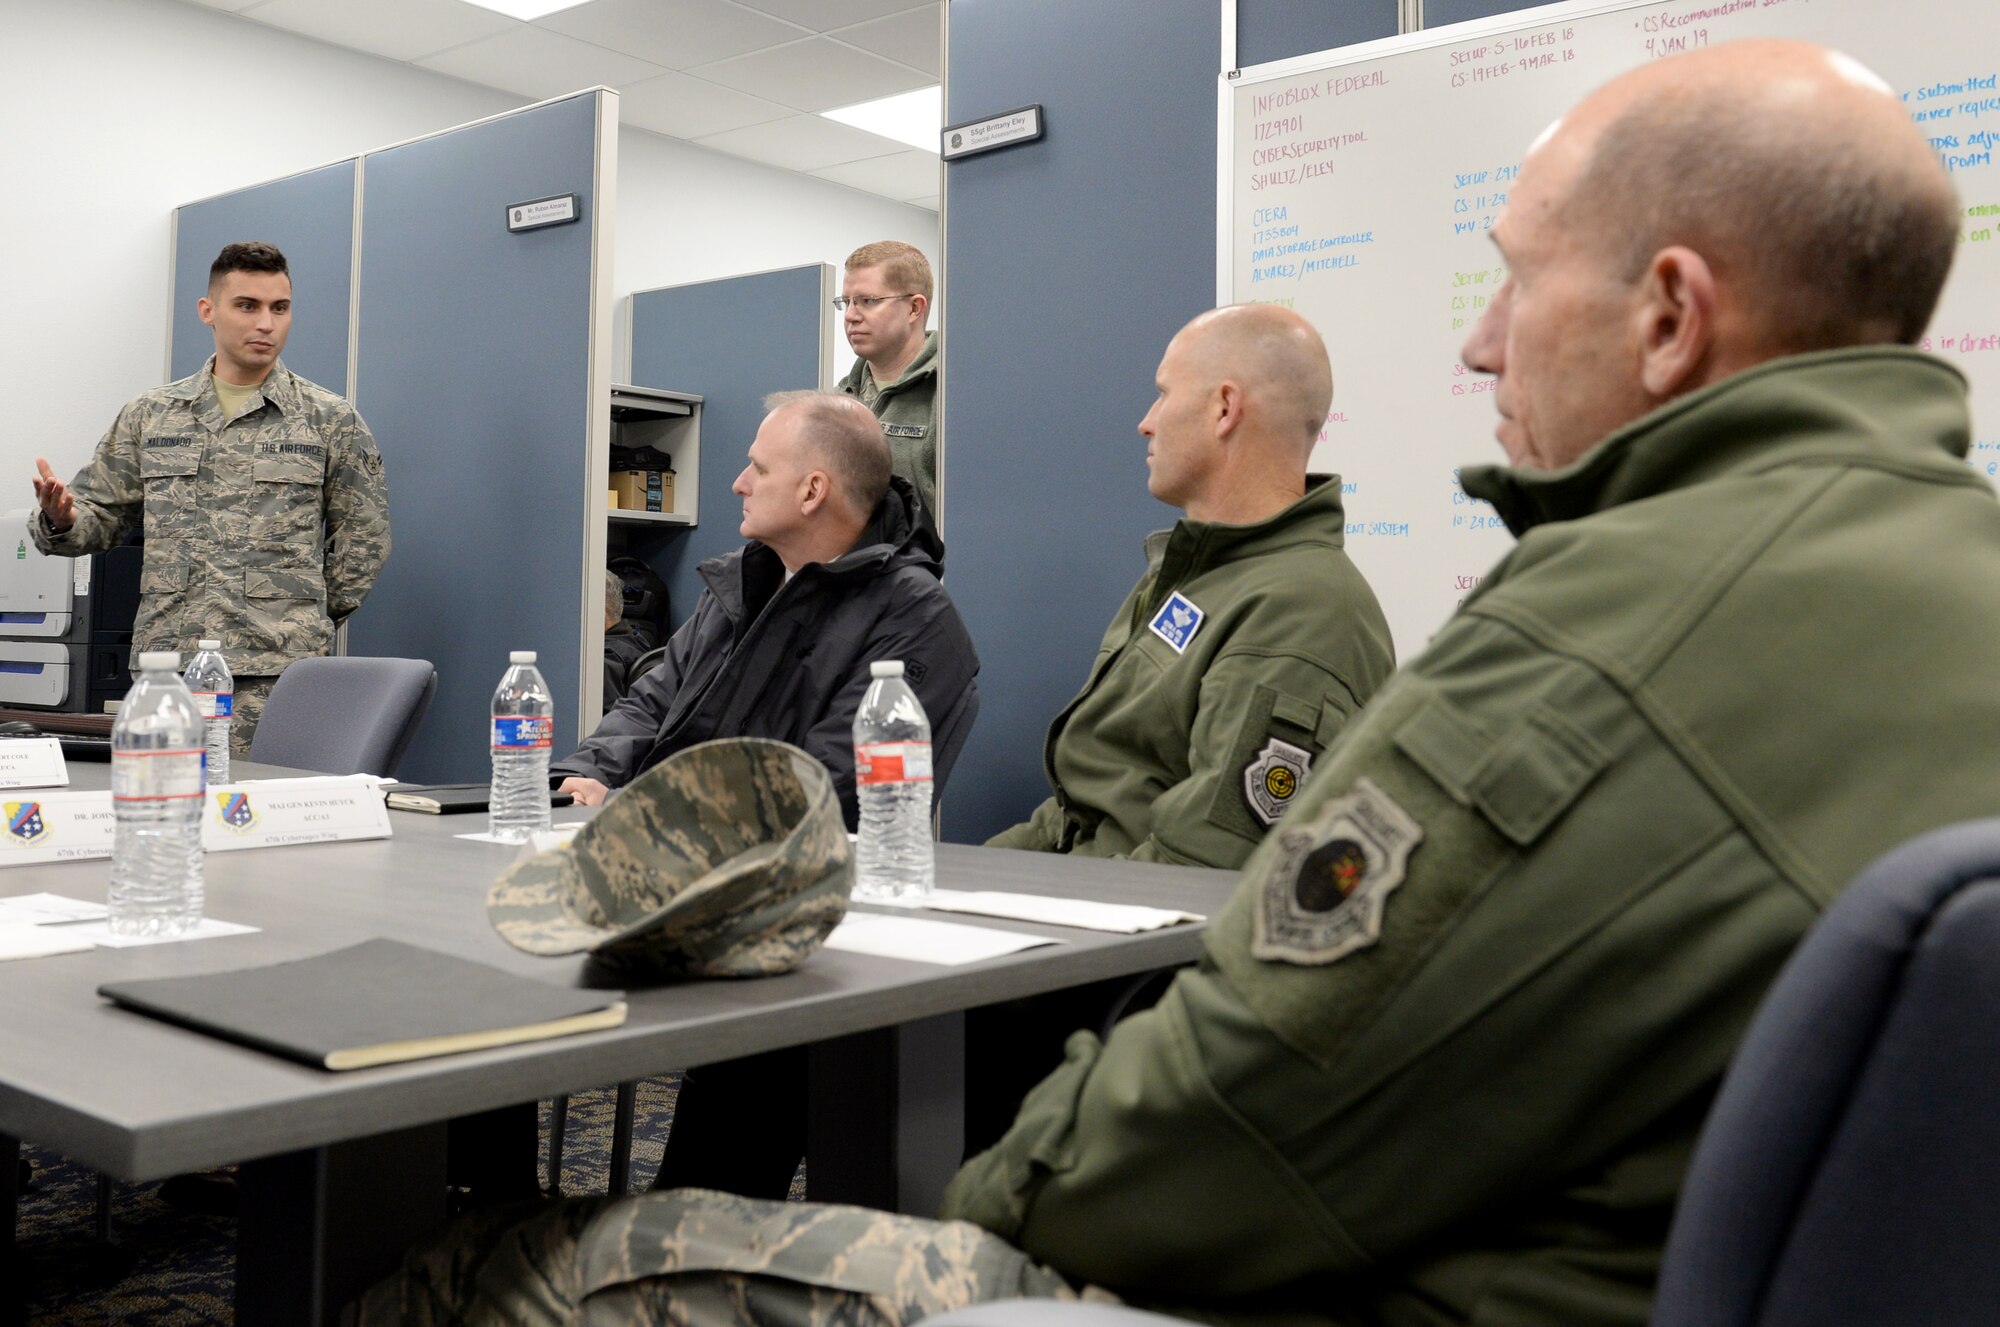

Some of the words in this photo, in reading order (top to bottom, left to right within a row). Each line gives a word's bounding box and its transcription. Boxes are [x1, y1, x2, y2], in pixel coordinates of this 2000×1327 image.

[1562, 27, 1574, 41] 18
[1645, 38, 1655, 58] 4
[1657, 35, 1686, 58] JAN
[1693, 29, 1709, 47] 19
[1562, 48, 1575, 62] 18
[1253, 84, 1320, 118] INFOBLOX
[1327, 70, 1390, 97] FEDERAL
[1342, 131, 1368, 147] TOOL
[1253, 206, 1288, 227] CTERA
[1275, 239, 1318, 257] STORAGE
[1319, 230, 1374, 250] CONTROLLER
[887, 425, 901, 435] AIR
[901, 425, 923, 436] FORCE
[279, 444, 294, 454] AIR
[294, 444, 323, 456] FORCE
